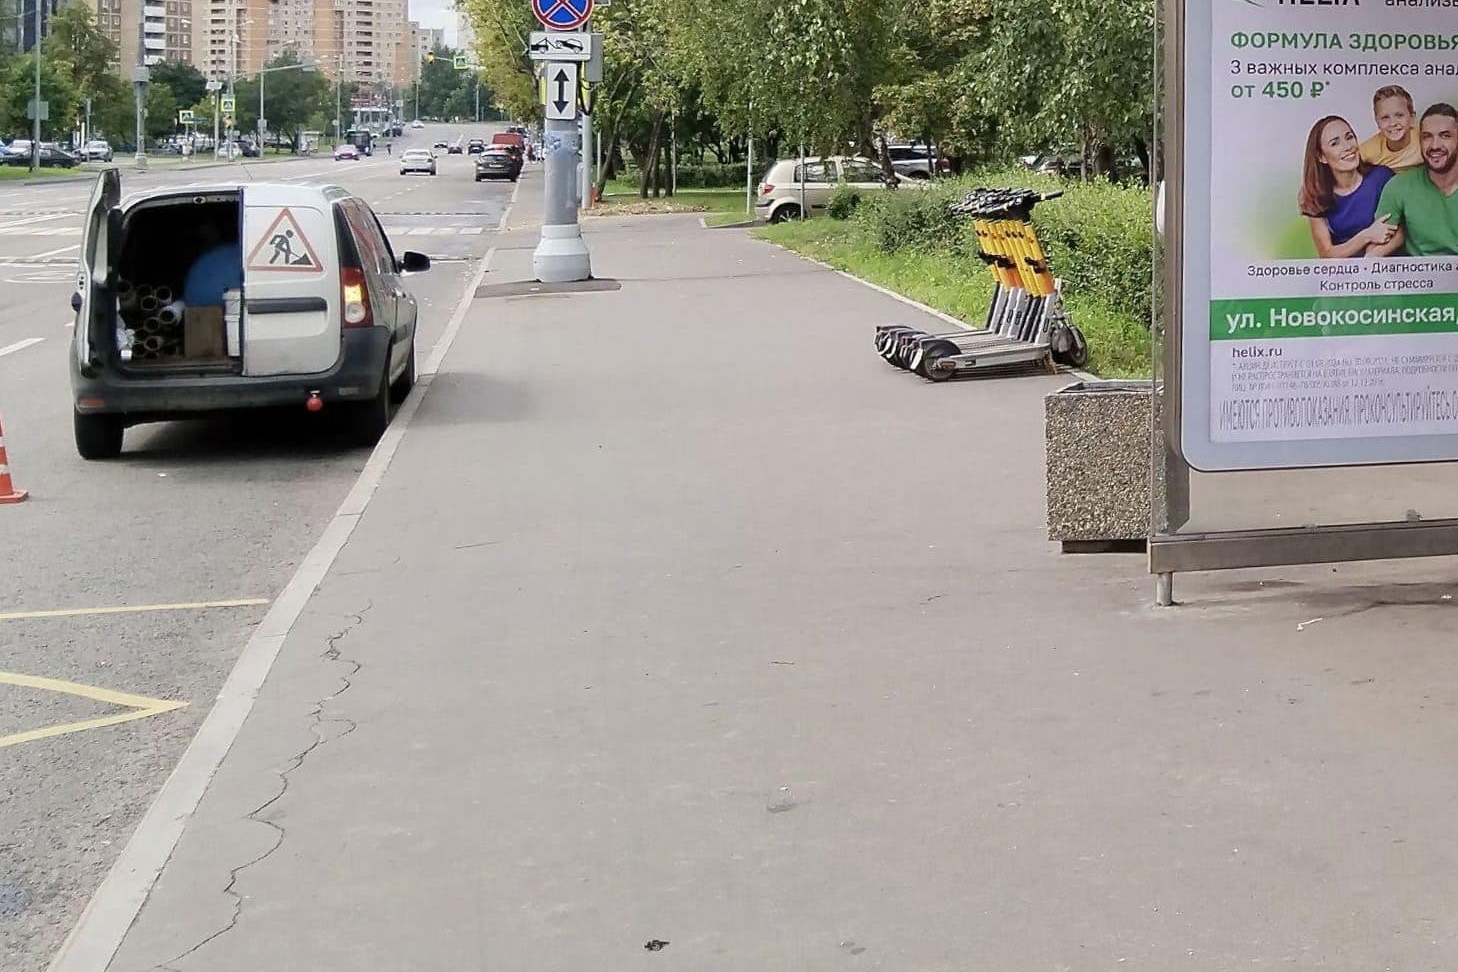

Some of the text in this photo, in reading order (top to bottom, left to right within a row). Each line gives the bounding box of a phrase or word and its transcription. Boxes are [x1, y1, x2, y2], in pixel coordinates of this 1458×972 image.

[1231, 32, 1342, 50] ФОРМУЛА
[1231, 60, 1241, 75] 3
[1247, 62, 1318, 76] важных
[1323, 62, 1419, 77] комплекса
[1231, 86, 1255, 98] от
[1262, 81, 1303, 98] 450
[1247, 265, 1311, 278] Здоровье
[1314, 264, 1360, 277] сердца
[1370, 261, 1453, 275] Диагностика
[1319, 278, 1434, 291] Контроль стресса
[1226, 312, 1262, 334] ул.
[1232, 346, 1283, 358] helix.ru
